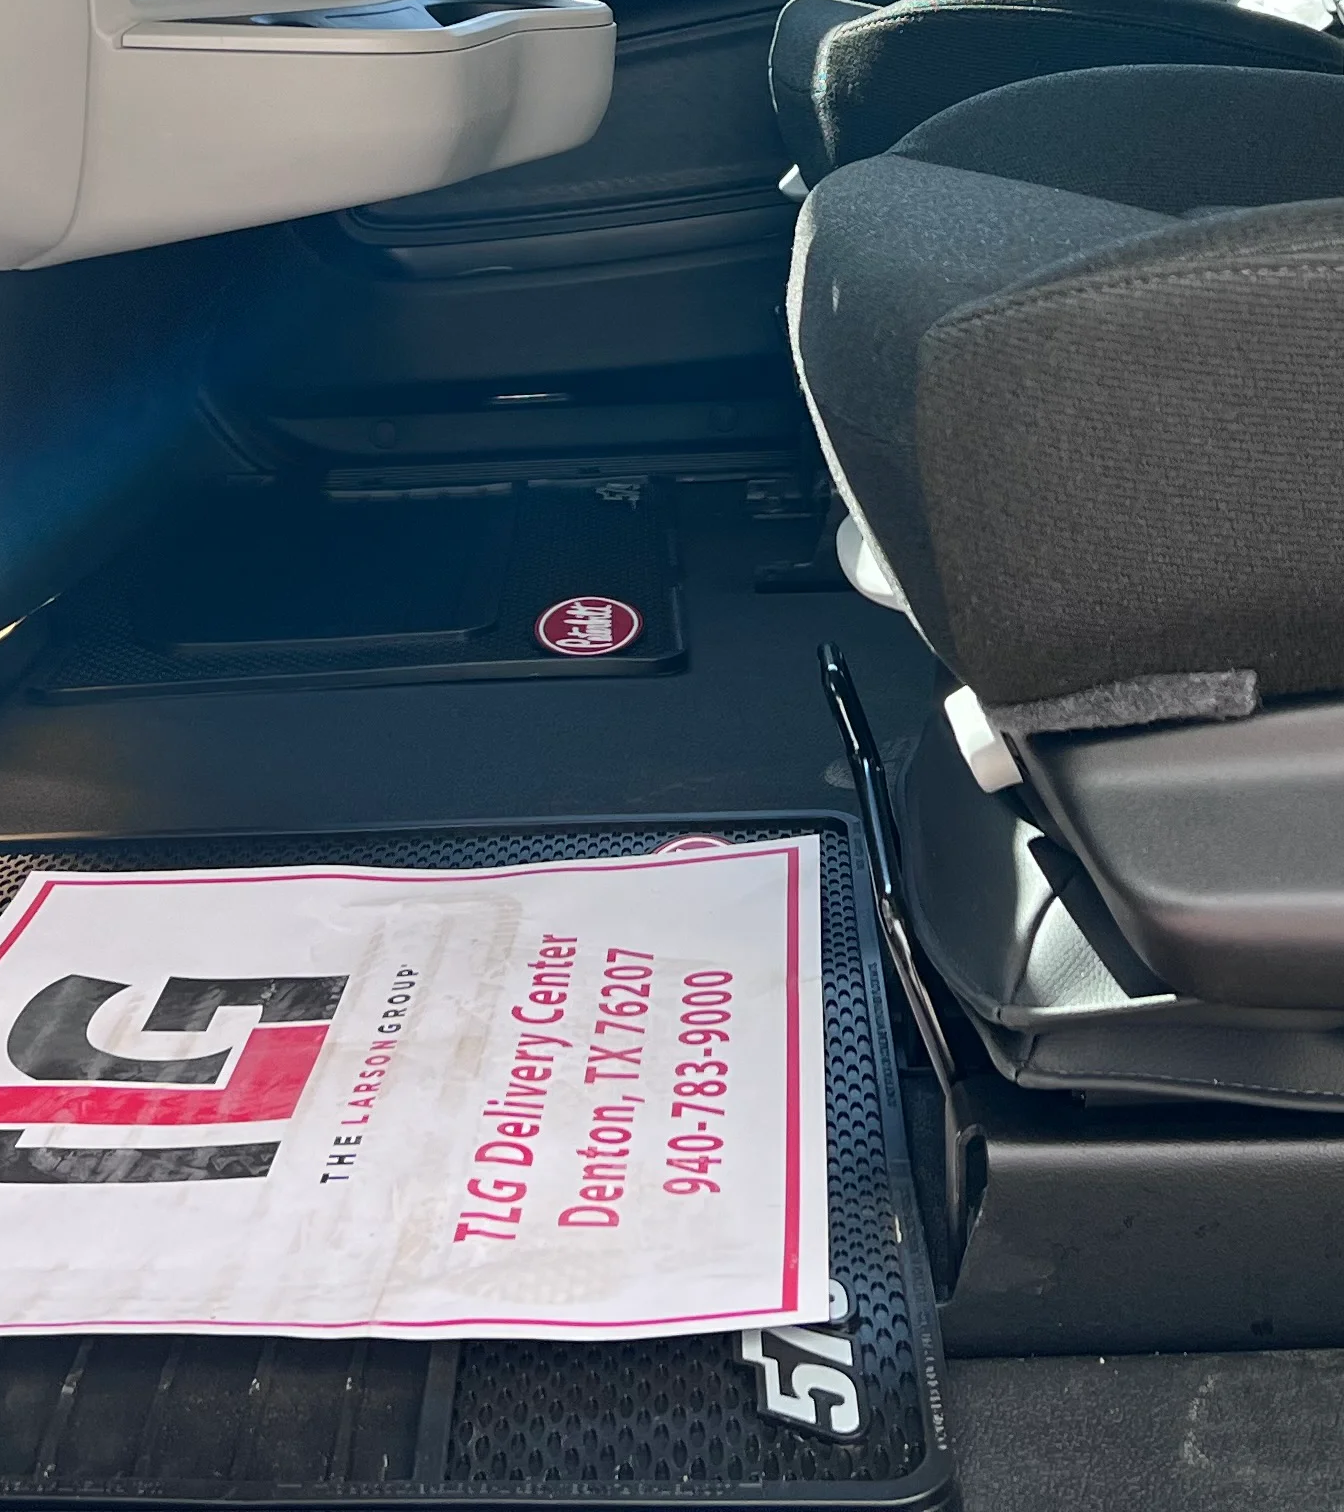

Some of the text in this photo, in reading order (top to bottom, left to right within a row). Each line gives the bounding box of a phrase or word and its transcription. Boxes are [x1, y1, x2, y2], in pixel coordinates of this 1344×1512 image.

[320, 967, 419, 1185] THE LARSON GROUP
[453, 934, 578, 1243] TLG Delivery Center
[558, 948, 654, 1228] Denton, TX 76207
[662, 970, 734, 1196] 940-783-9000
